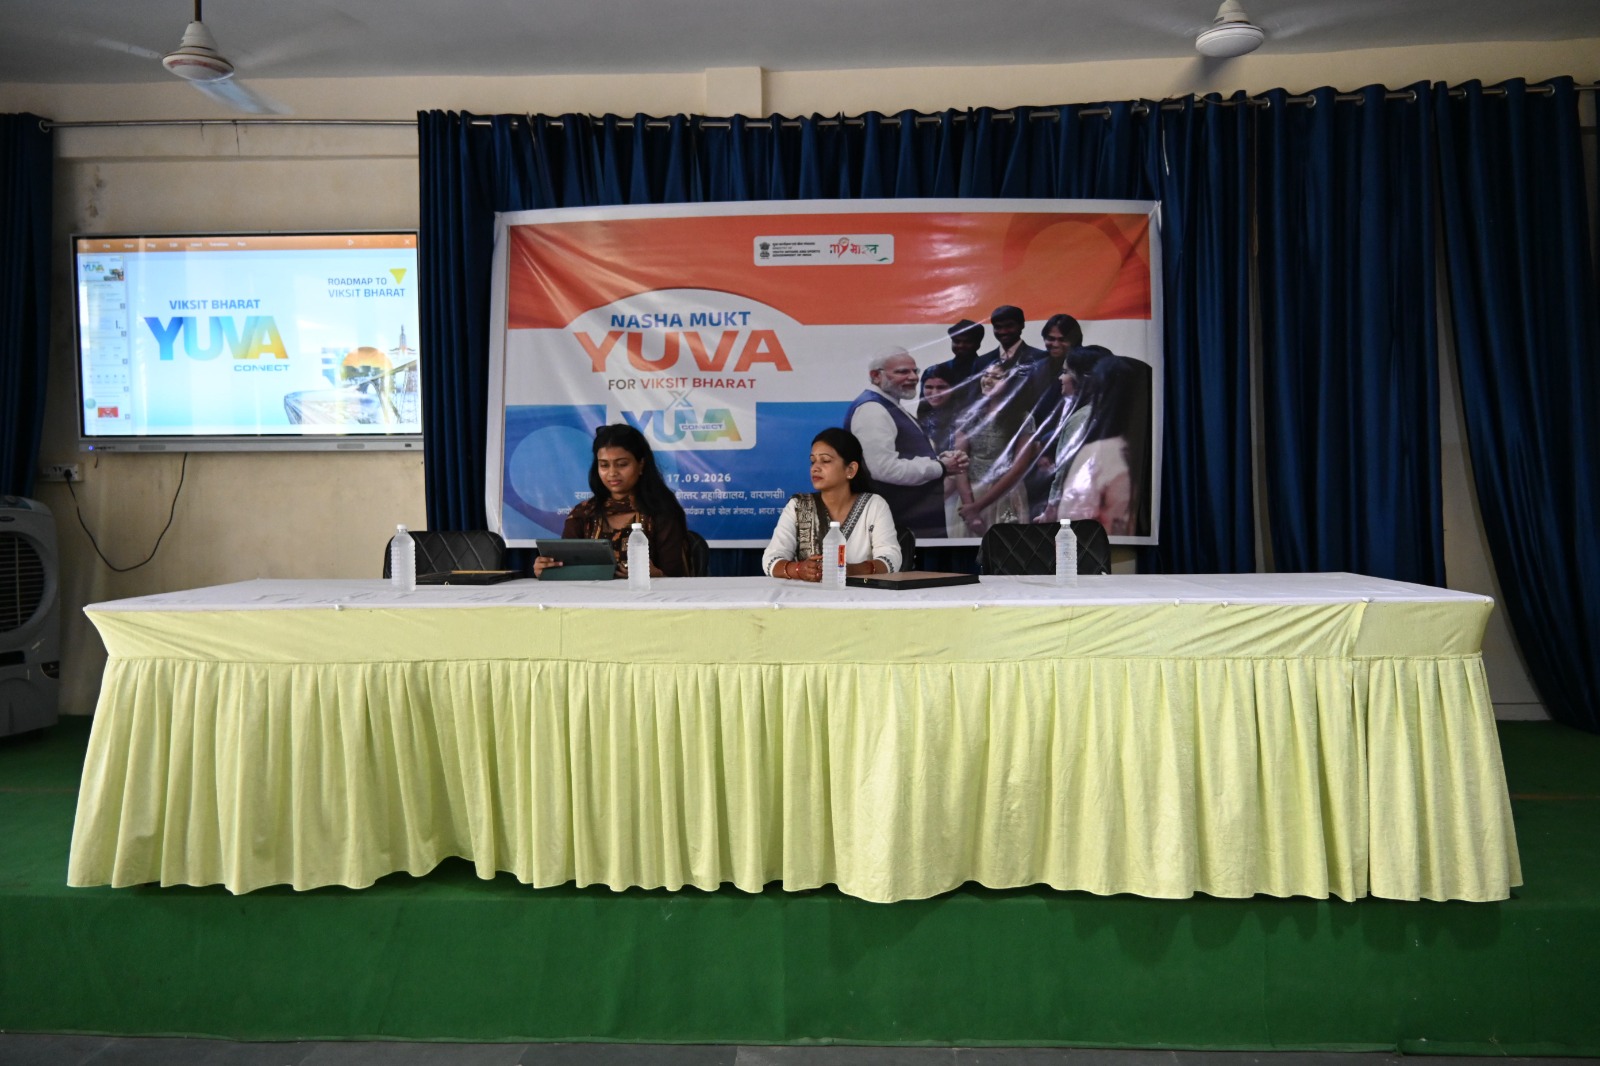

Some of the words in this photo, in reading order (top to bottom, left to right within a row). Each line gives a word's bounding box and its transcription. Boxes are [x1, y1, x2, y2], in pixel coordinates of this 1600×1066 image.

[327, 277, 373, 286] ROADMAP
[375, 277, 387, 285] TO
[328, 288, 360, 298] VIKSIT
[363, 288, 405, 297] BHARAT
[169, 300, 208, 310] VIKSIT
[211, 299, 260, 309] BHARAT
[610, 313, 683, 328] NASHA
[689, 311, 751, 327] MUKT
[143, 315, 289, 361] YUVA
[573, 329, 793, 373] YUVA
[233, 364, 290, 372] CONNECT
[608, 379, 636, 390] FOR
[640, 377, 688, 389] VIKSIT
[692, 378, 756, 389] BHARAT
[620, 408, 743, 443] YUVA
[681, 423, 723, 431] CONNECT
[667, 473, 732, 483] 17.09.2026
